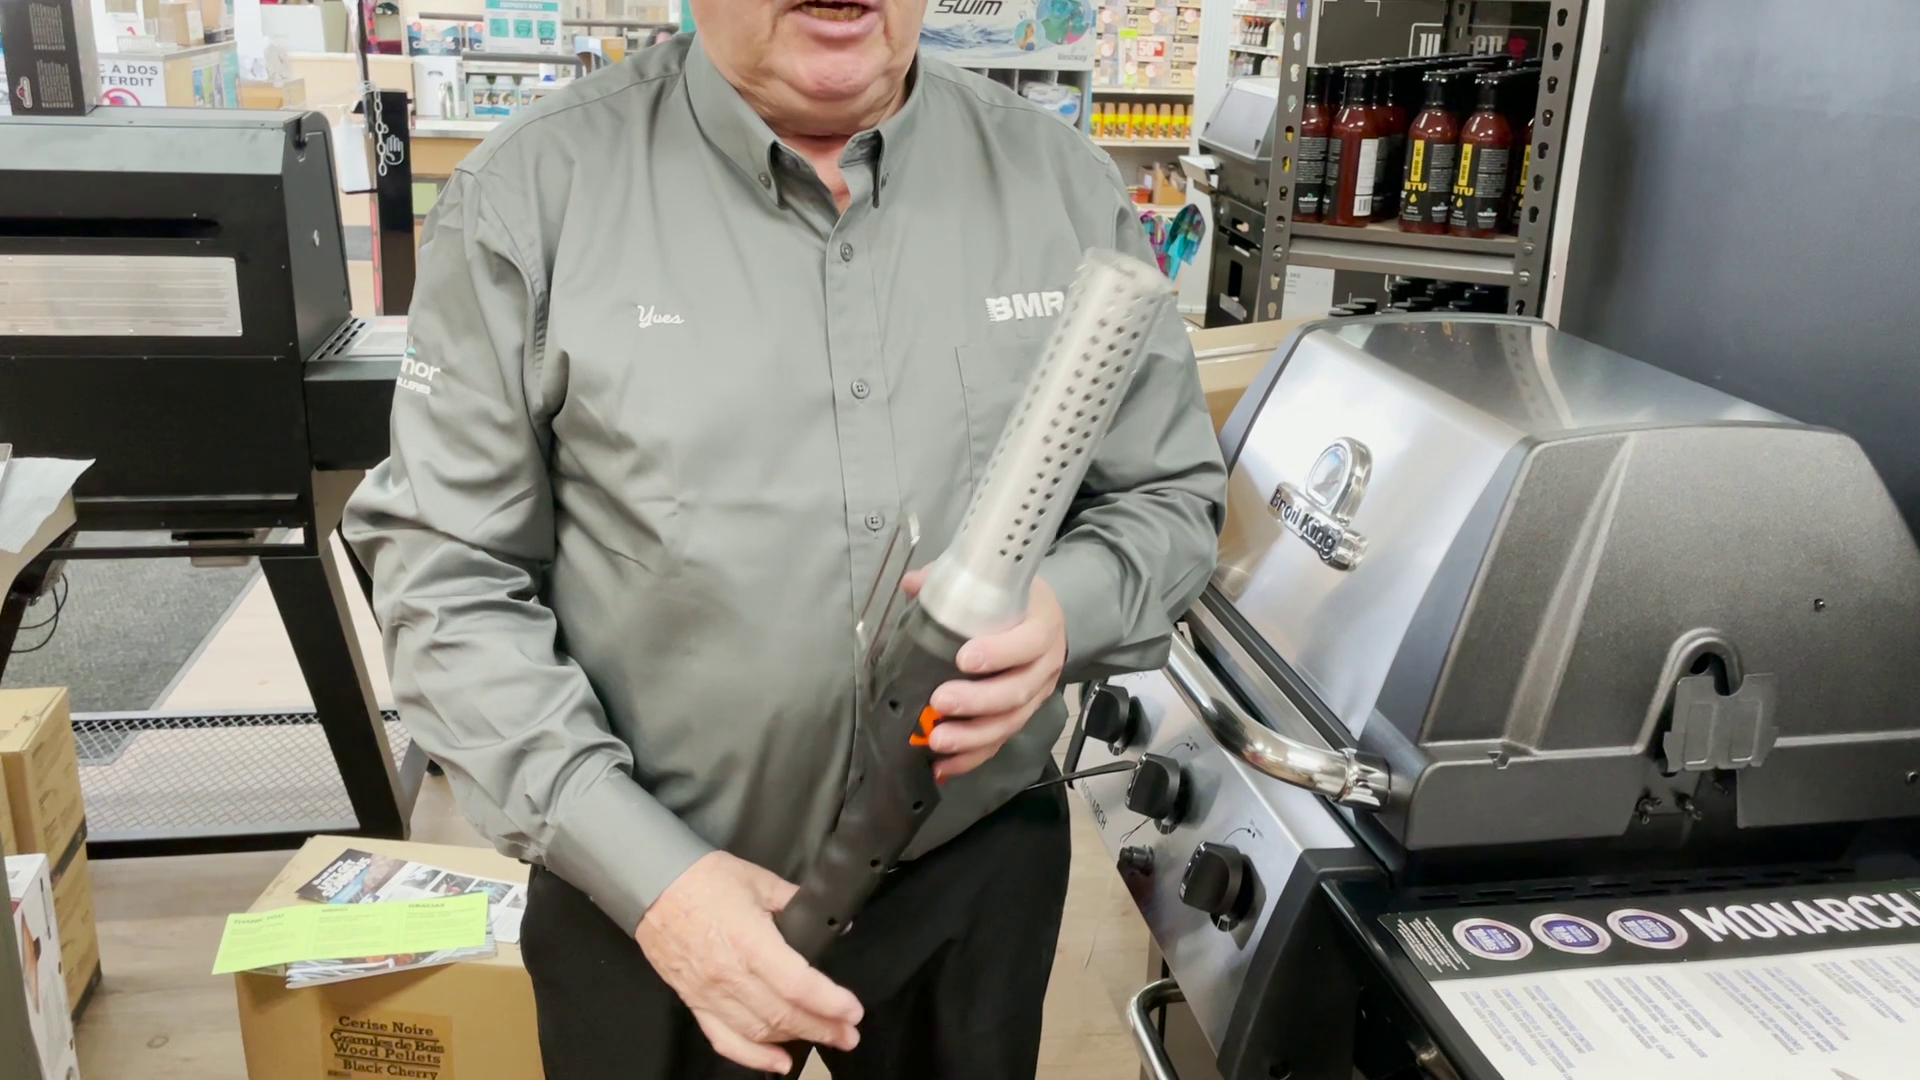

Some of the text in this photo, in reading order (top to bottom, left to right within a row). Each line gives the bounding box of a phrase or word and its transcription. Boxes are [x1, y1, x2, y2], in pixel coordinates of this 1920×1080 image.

[127, 64, 158, 75] DOS
[637, 305, 685, 329] Yves
[985, 291, 1065, 322] BMR
[1270, 488, 1337, 560] Broil King
[1679, 893, 1920, 942] MONARCH
[338, 1016, 434, 1036] Cerise Noire
[330, 1030, 445, 1053] Granules de Bois
[334, 1041, 441, 1063] Wood Pellets
[343, 1059, 383, 1074] Black
[386, 1064, 438, 1080] Cherry
